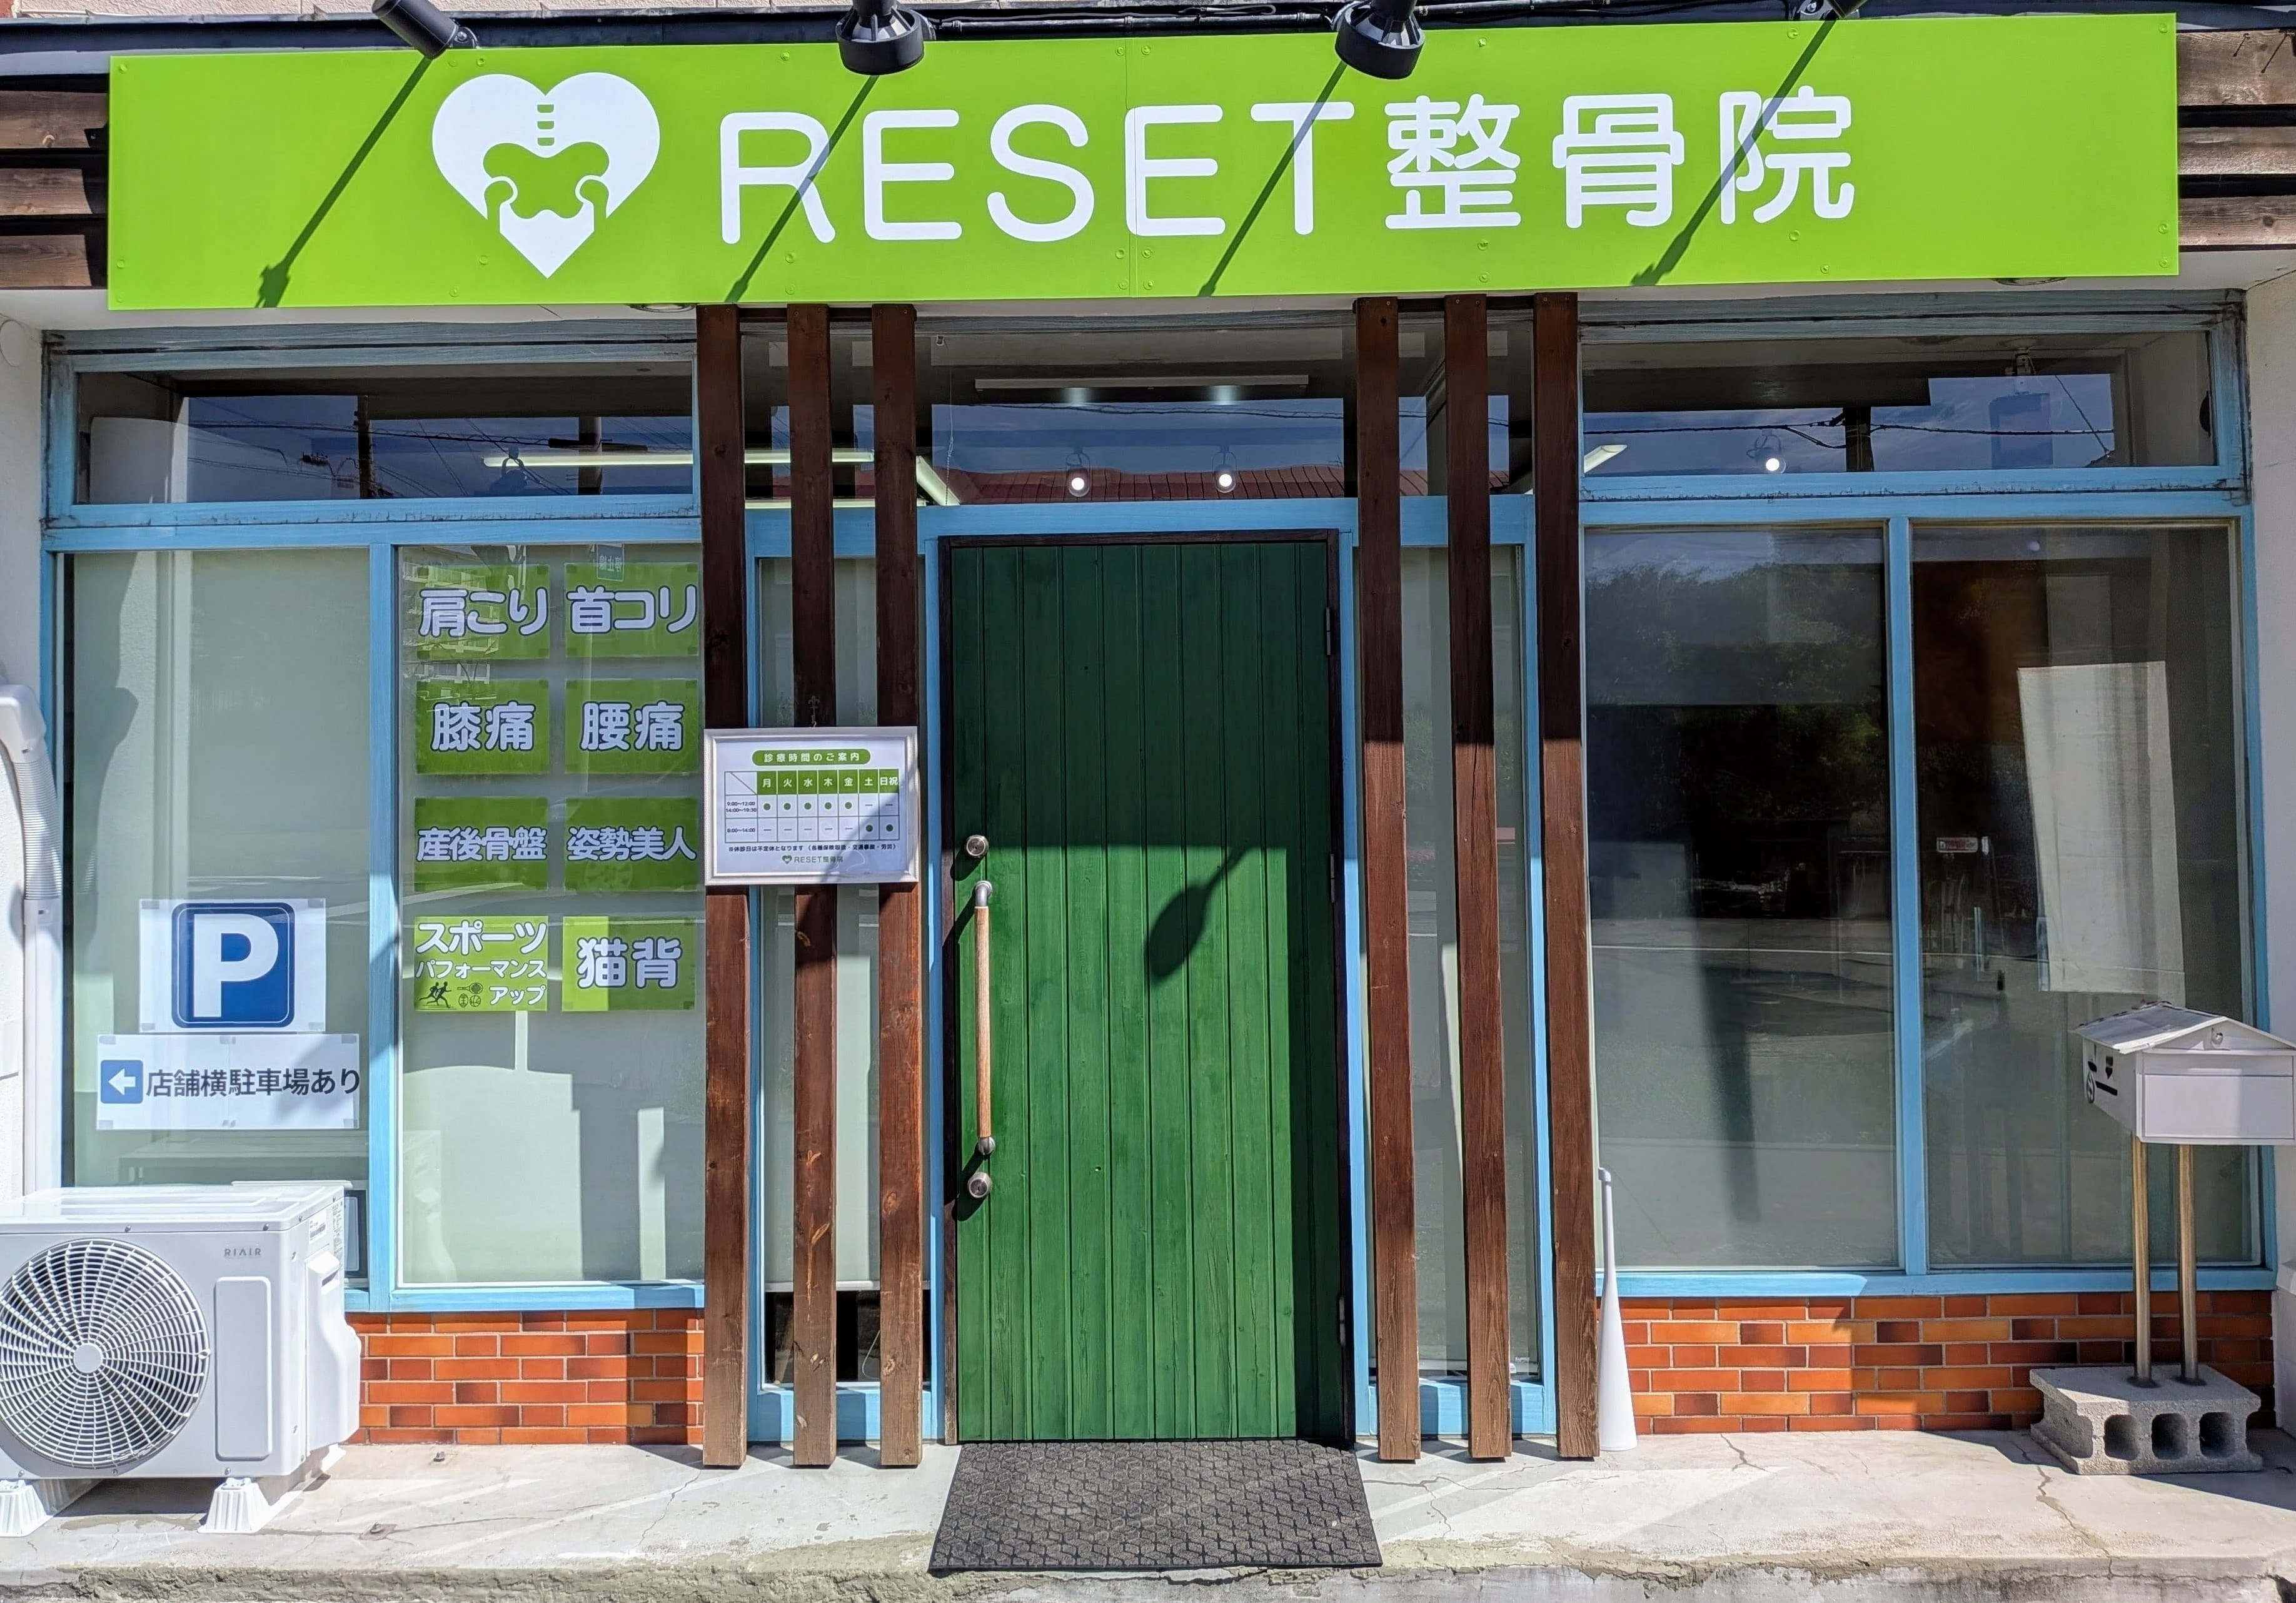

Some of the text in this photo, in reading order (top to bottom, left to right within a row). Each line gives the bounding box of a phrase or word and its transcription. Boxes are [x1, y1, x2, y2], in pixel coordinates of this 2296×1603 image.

[719, 85, 1856, 245] RESET整骨院
[418, 587, 548, 637] 肩こり
[566, 585, 697, 634] 首コリ
[431, 702, 536, 752] 膝痛
[580, 701, 685, 751] 腰痛
[763, 752, 860, 763] 診療時間のご案内
[762, 776, 899, 788] 月 火 水 木 金 土 日祝
[417, 826, 547, 862] 産後骨盤
[566, 826, 697, 861] 姿勢美人
[416, 920, 547, 955] スポーツ
[193, 913, 279, 1018] P
[416, 959, 548, 980] パフォーマンス
[577, 938, 682, 989] 猫背
[489, 984, 547, 1006] アップ
[146, 1068, 360, 1097] 店舗横駐車場あり
